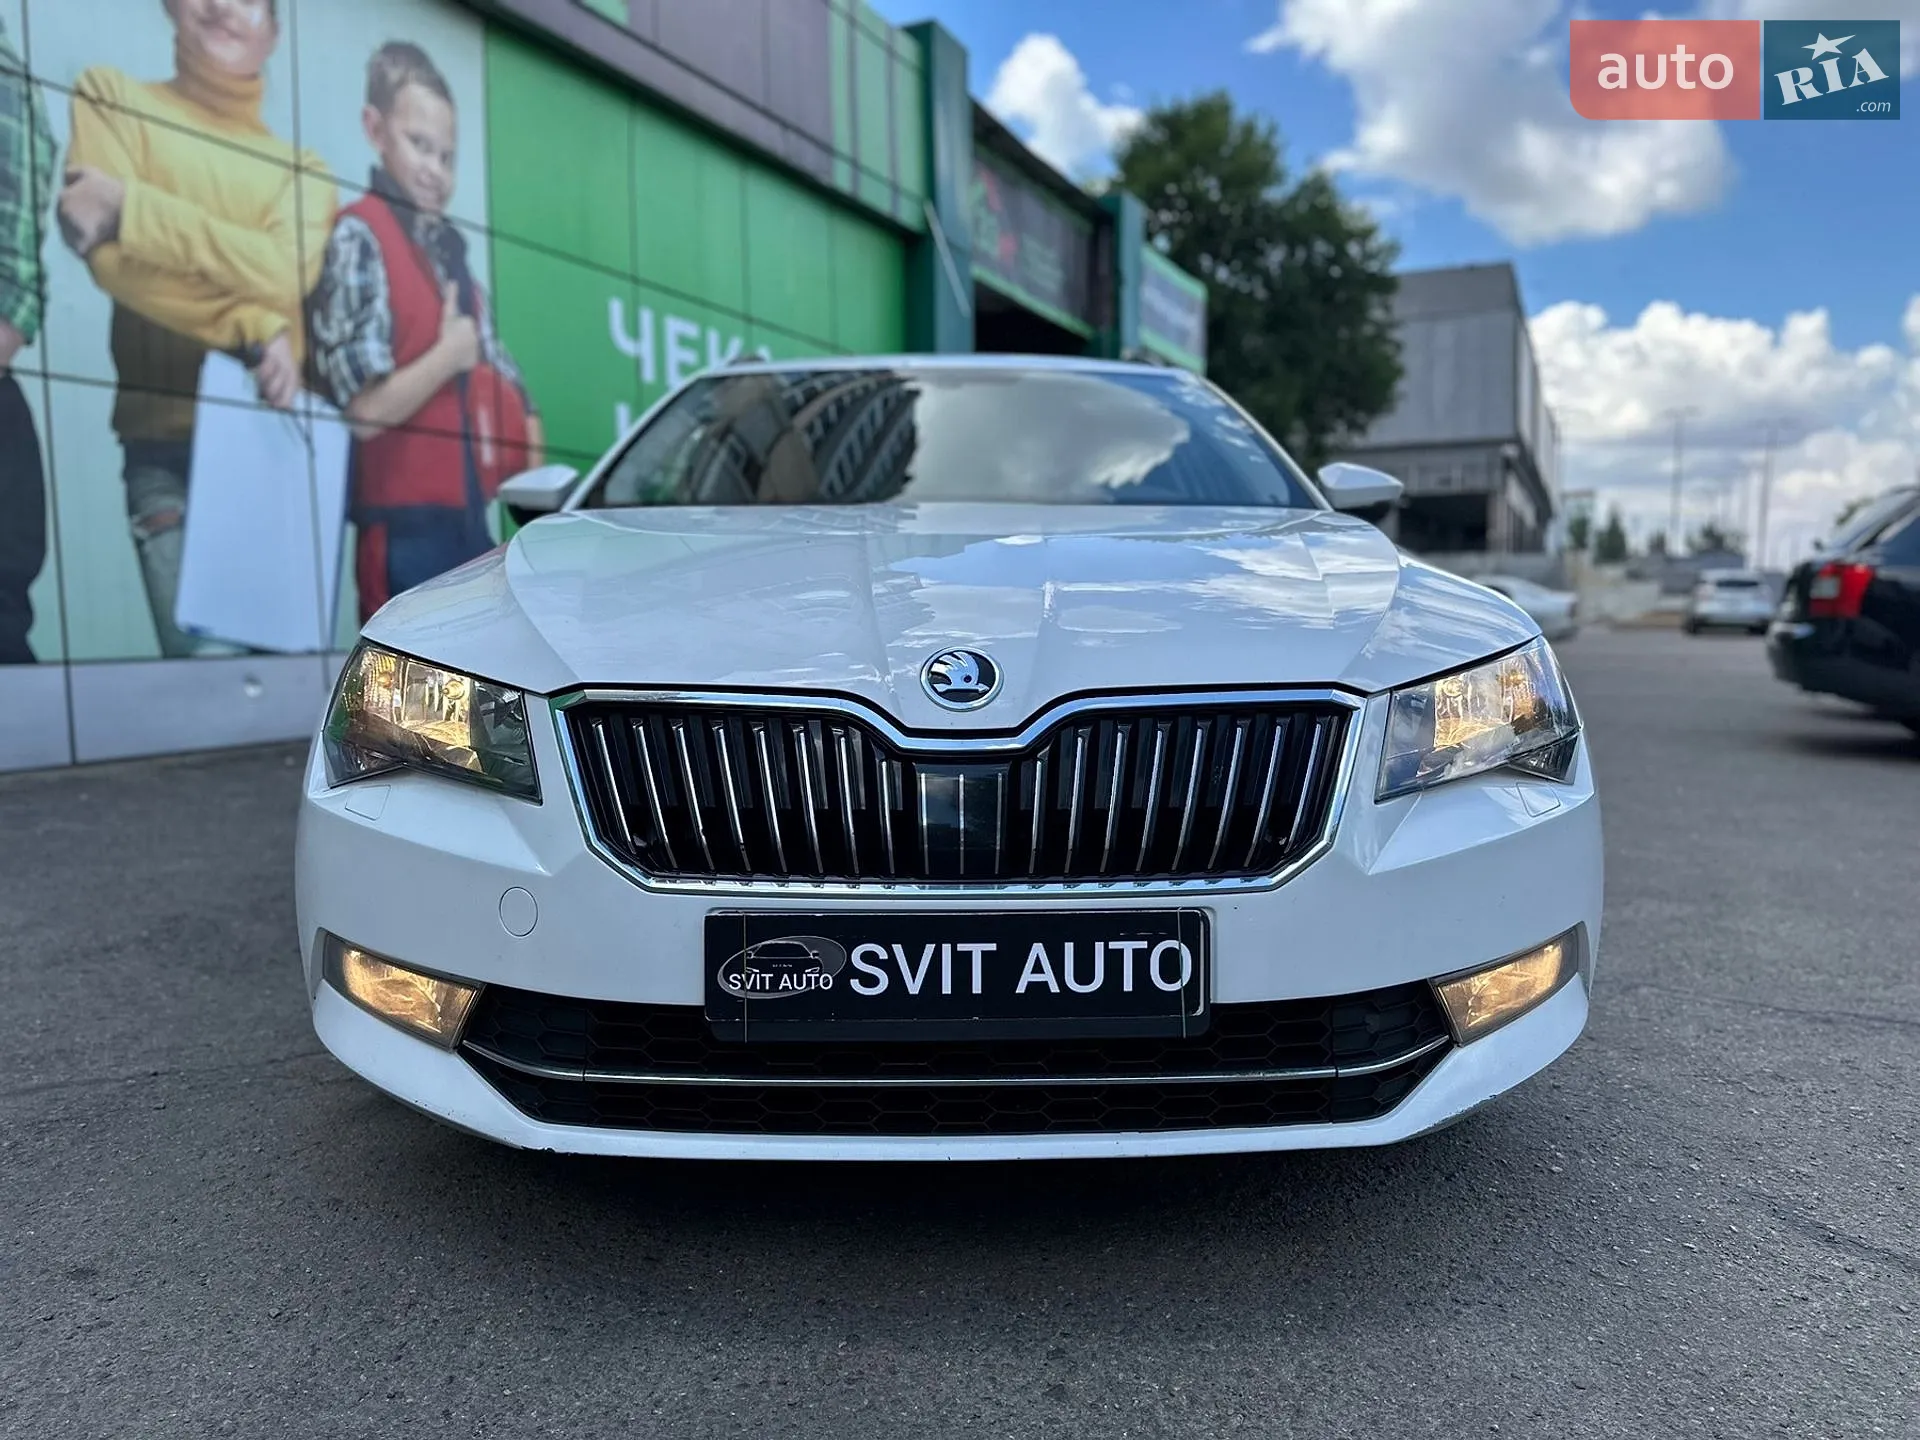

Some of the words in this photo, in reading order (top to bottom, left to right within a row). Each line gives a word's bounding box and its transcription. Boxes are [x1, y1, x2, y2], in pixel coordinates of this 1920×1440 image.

[608, 296, 772, 388] ЧЕК
[728, 973, 774, 990] SVIT
[778, 973, 833, 990] AUTO
[850, 943, 997, 996] SVIT
[1015, 939, 1192, 994] AUTO
